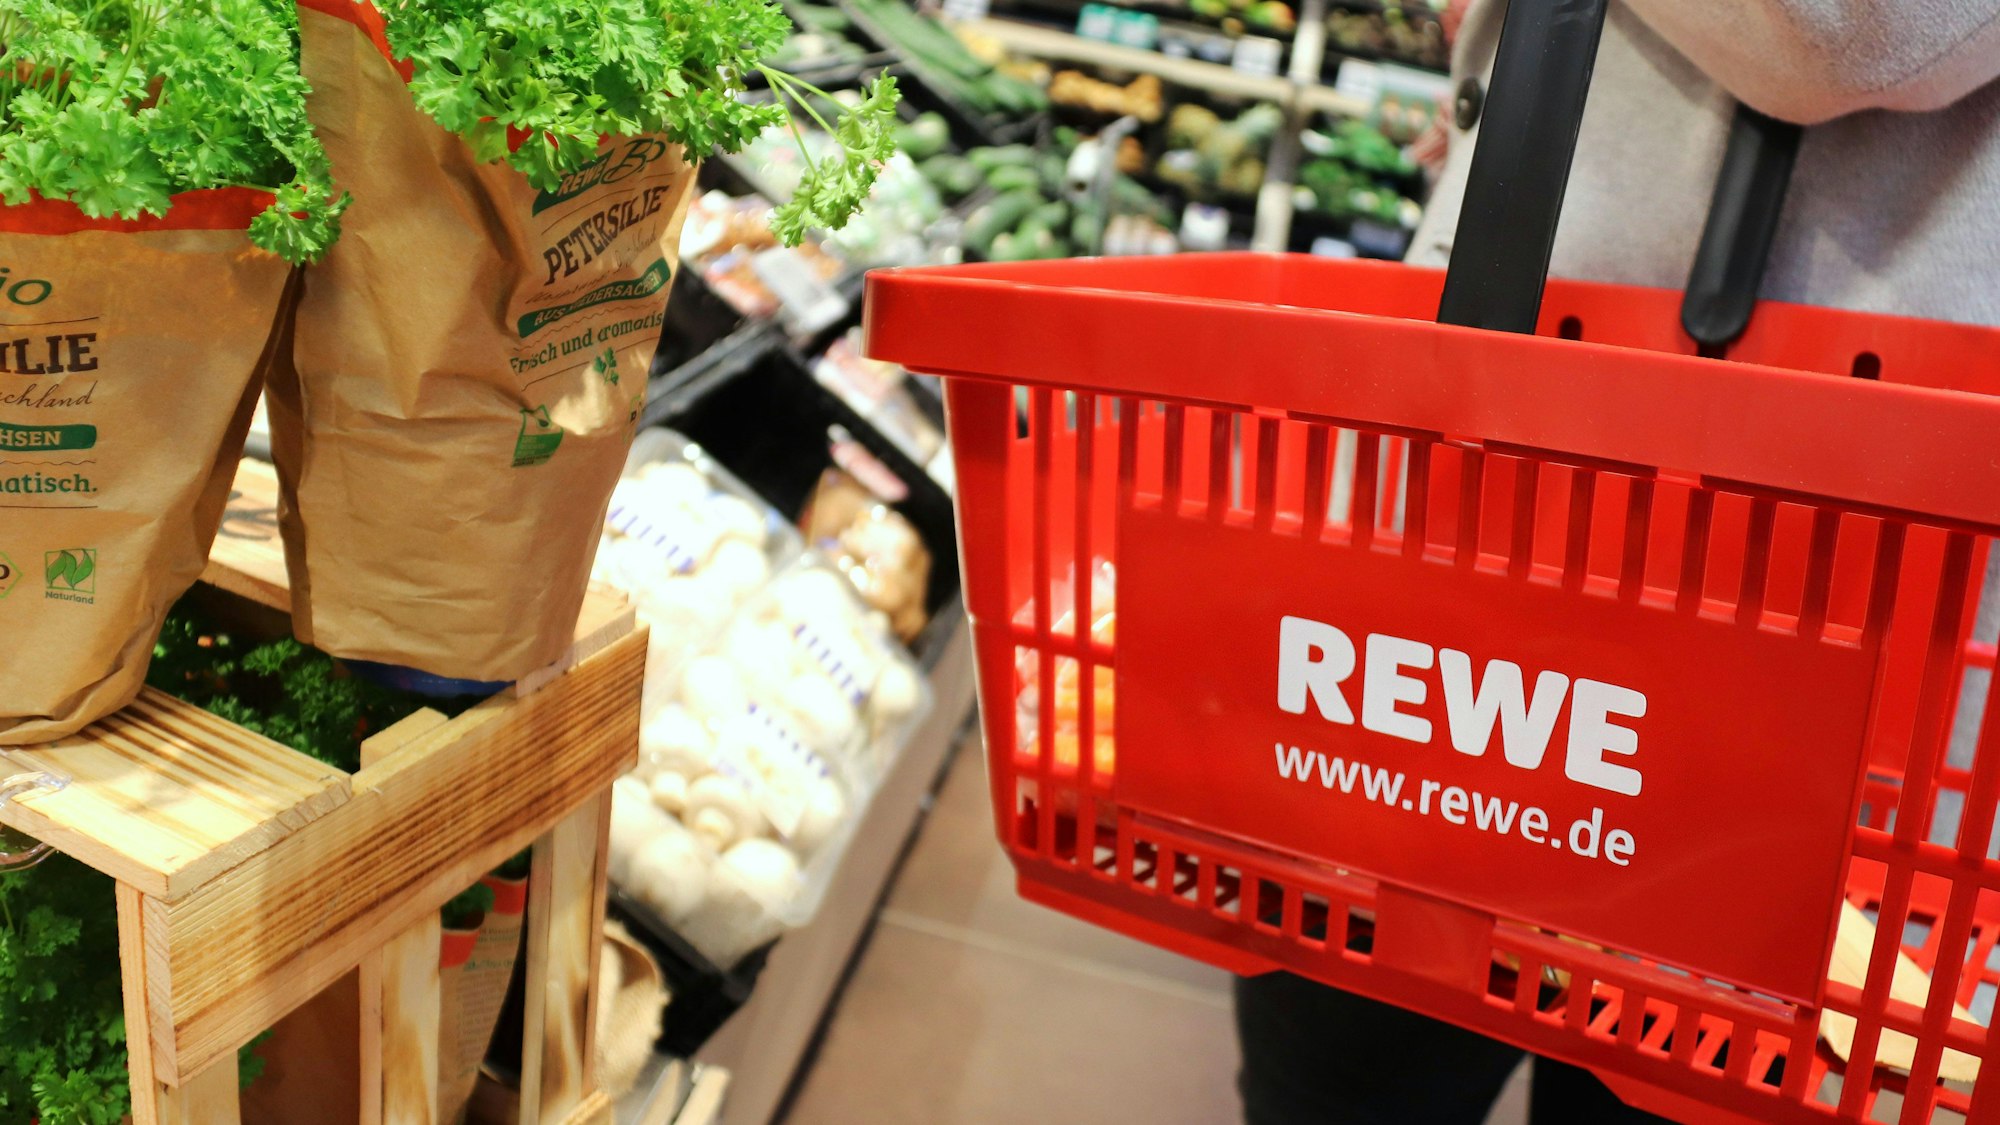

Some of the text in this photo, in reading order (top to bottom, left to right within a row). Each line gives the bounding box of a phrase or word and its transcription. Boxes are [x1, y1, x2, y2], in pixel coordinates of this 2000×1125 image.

[557, 160, 606, 197] REWE
[543, 185, 671, 286] PETERSILIE
[534, 306, 566, 326] AUS
[509, 339, 558, 377] Frisch
[561, 328, 594, 357] und
[0, 472, 98, 494] atisch.
[45, 591, 94, 605] Naturland
[1276, 615, 1648, 797] REWE
[1274, 742, 1636, 867] www.rewe.de
